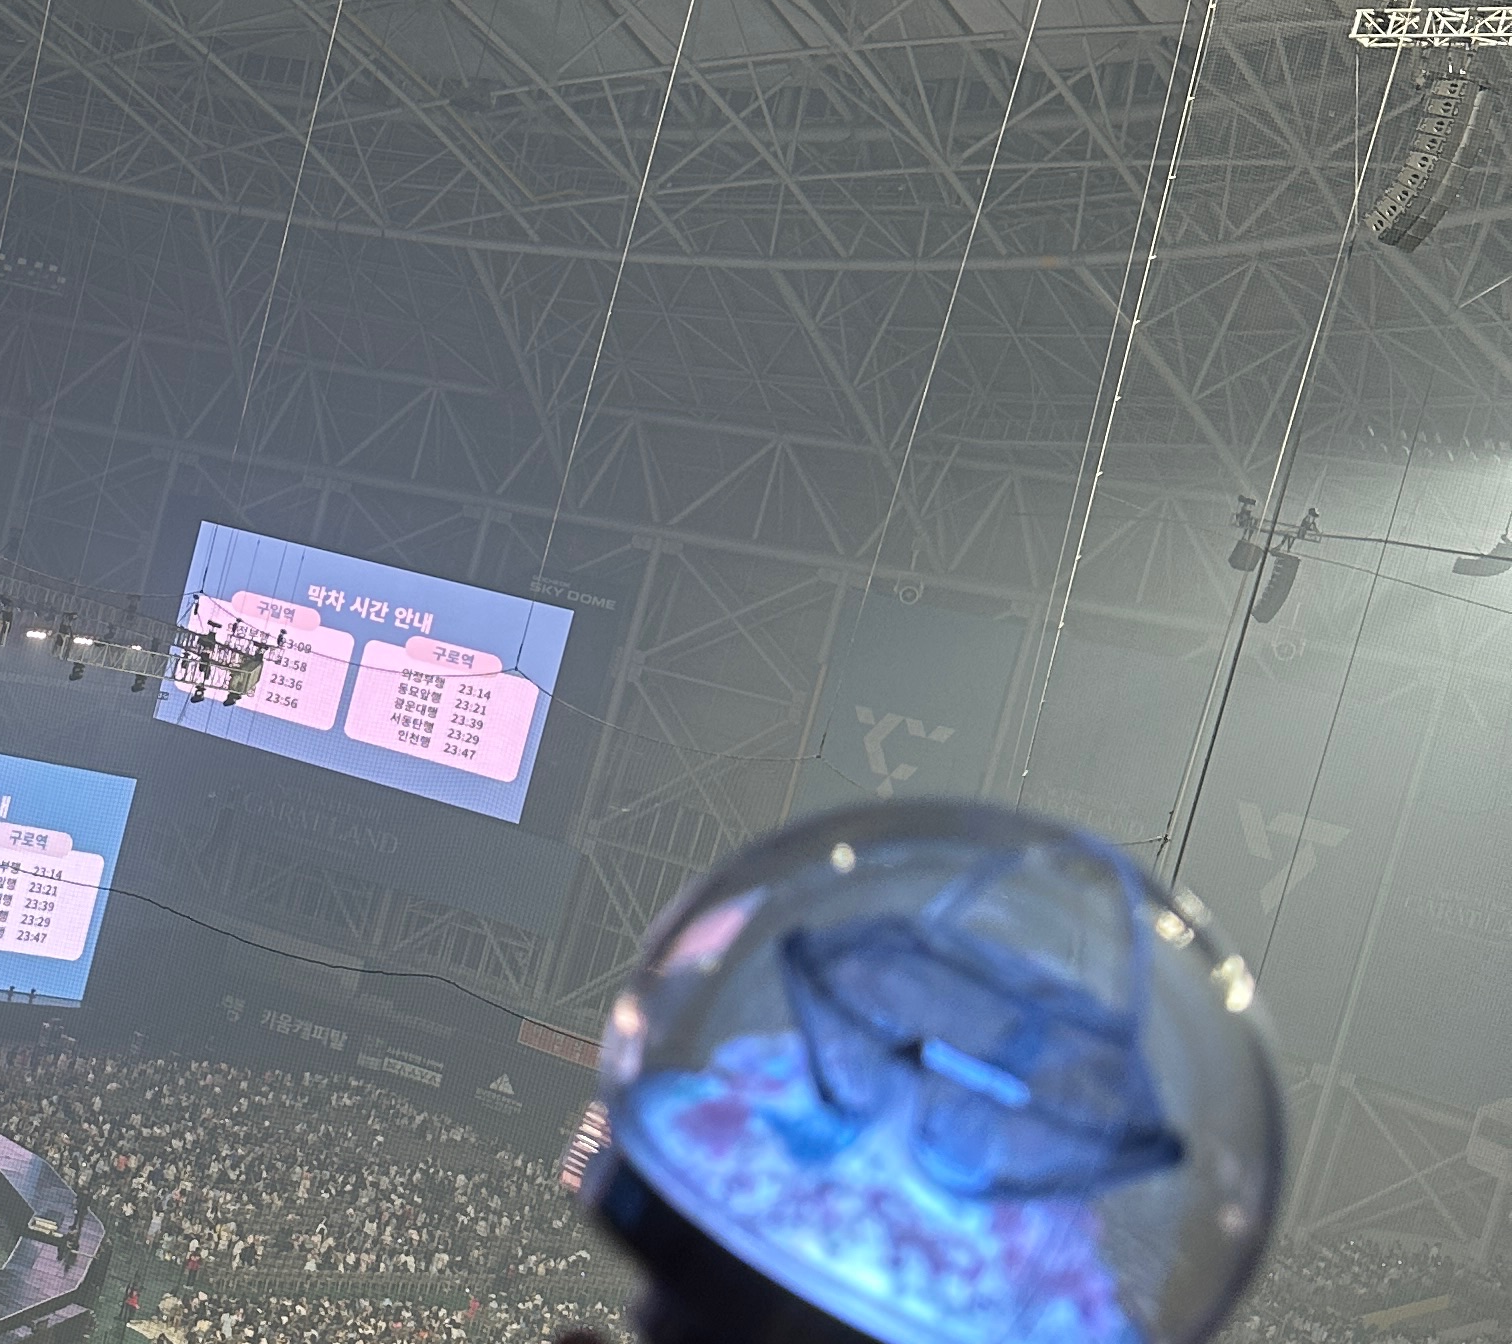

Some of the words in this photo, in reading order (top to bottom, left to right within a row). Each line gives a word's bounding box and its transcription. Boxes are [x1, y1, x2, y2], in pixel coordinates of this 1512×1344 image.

[529, 581, 564, 597] SKY
[567, 590, 617, 610] DOME
[256, 600, 296, 622] 구일역
[308, 584, 345, 613] 막차
[350, 593, 388, 623] 시간
[395, 606, 434, 634] 안내
[432, 646, 475, 669] 구로역
[270, 674, 303, 691] 23:36
[458, 683, 491, 700] 23:14
[265, 692, 299, 709] 23:56
[454, 699, 487, 715] 23:21
[450, 714, 483, 730] 23:39
[397, 730, 431, 749] 인천행
[443, 743, 476, 760] 23:47
[447, 729, 480, 745] 23:29
[9, 829, 48, 849] 구로역
[32, 865, 63, 880] 23:14
[28, 882, 58, 897] 23:21
[25, 897, 55, 913] 23:39
[20, 913, 51, 928] 23:29
[16, 929, 48, 944] 23:47
